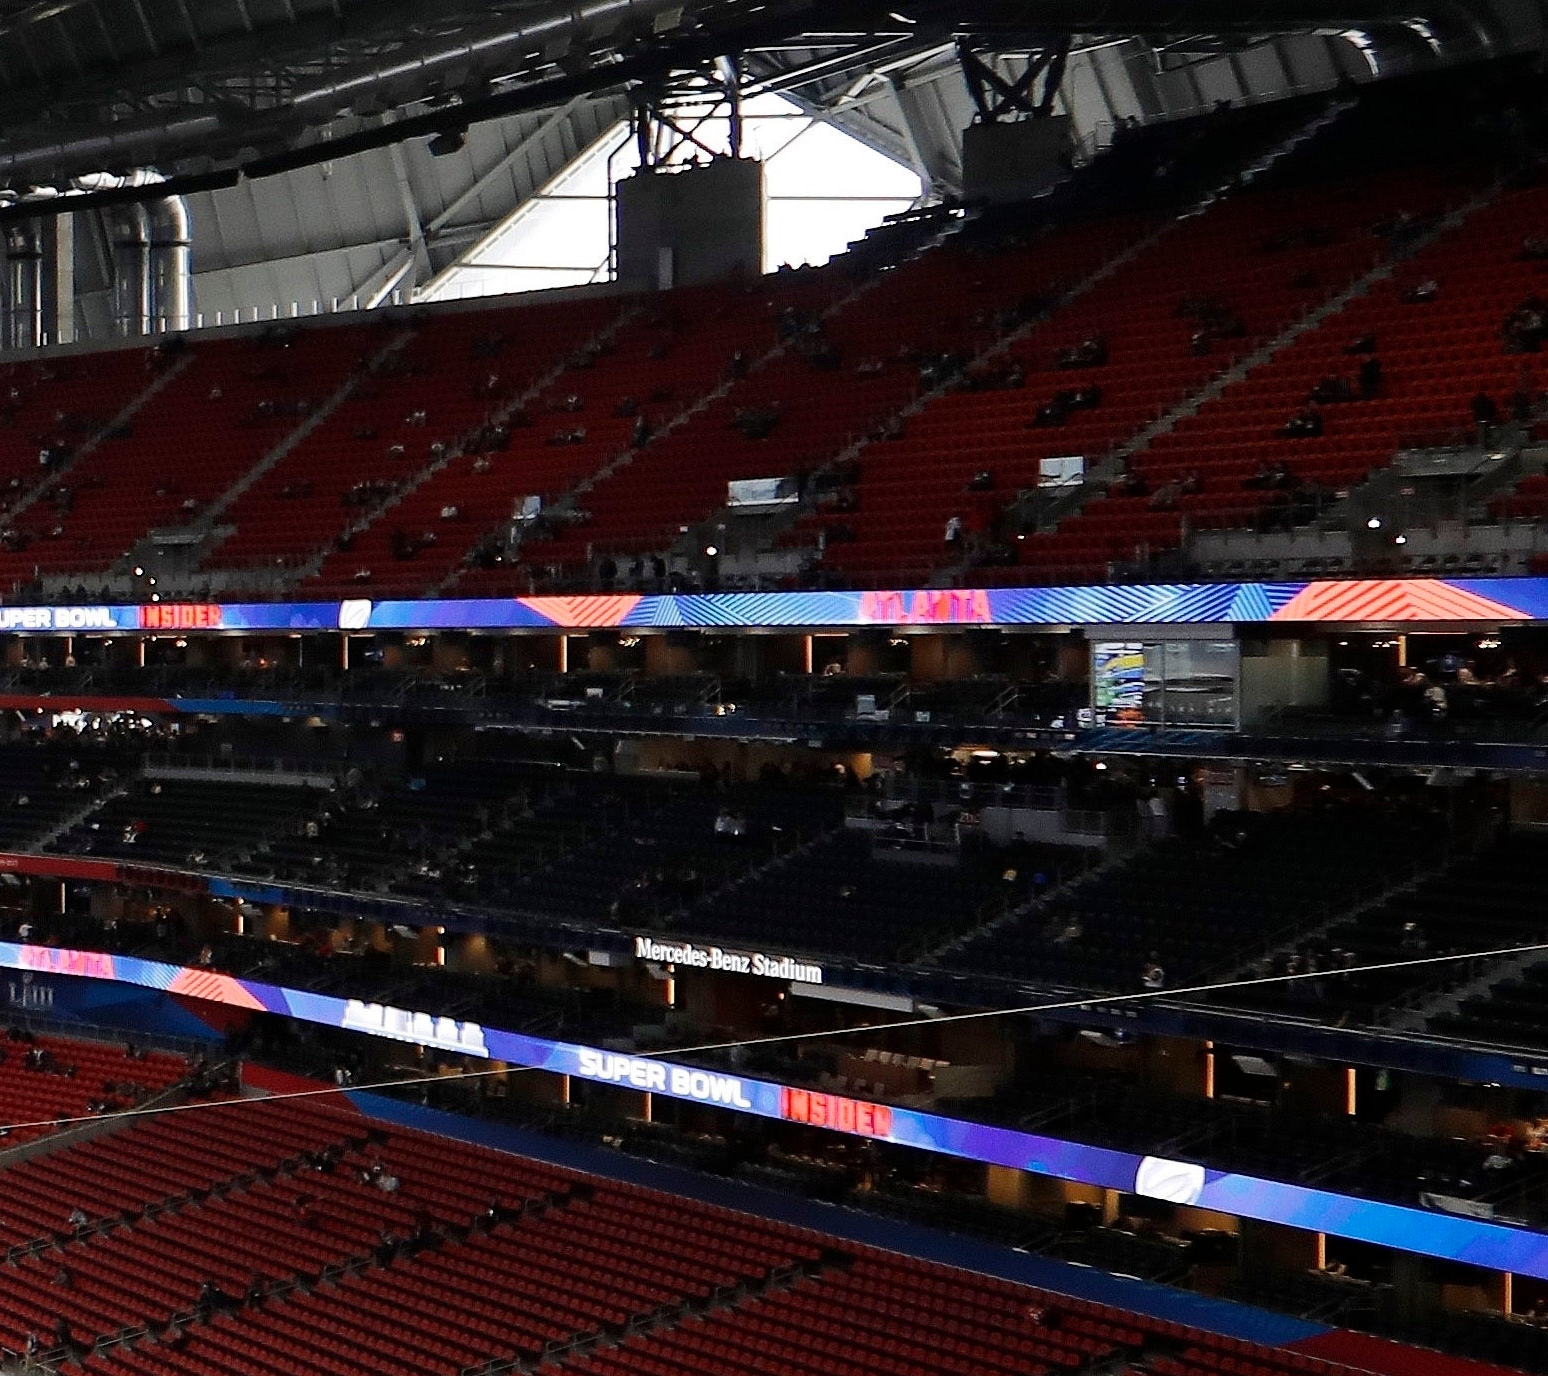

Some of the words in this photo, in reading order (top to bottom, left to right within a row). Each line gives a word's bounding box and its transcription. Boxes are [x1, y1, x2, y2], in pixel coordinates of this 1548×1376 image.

[54, 606, 117, 628] BOWL
[636, 935, 751, 974] Mercedes-Benz
[751, 952, 823, 985] Stadium
[579, 1048, 666, 1091] SUPER
[671, 1068, 752, 1109] BOWL
